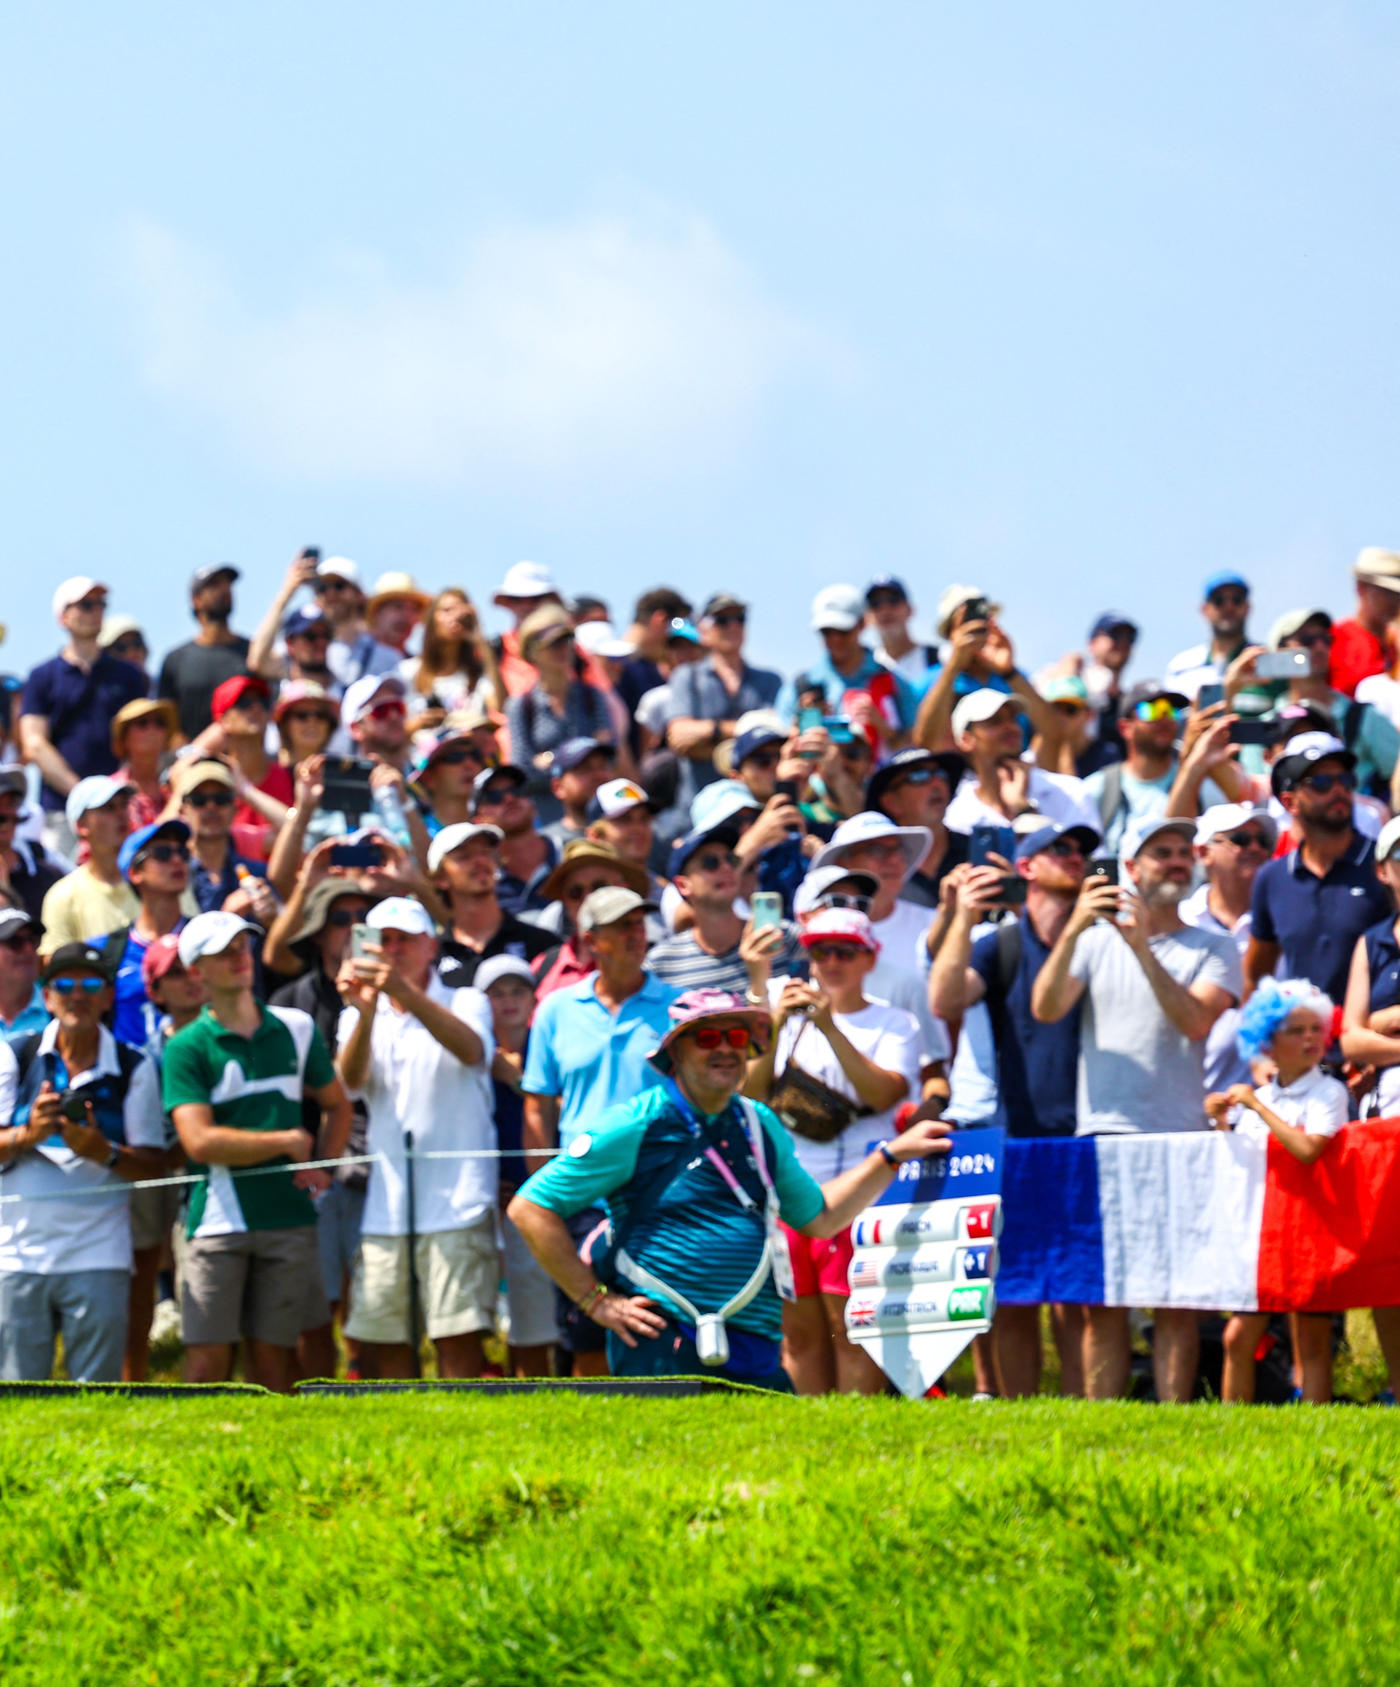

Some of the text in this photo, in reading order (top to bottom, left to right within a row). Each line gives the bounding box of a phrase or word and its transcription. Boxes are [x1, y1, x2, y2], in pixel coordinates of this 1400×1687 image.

[898, 1153, 995, 1181] PARIS 2024
[964, 1252, 987, 1271] +1
[950, 1290, 983, 1313] PAR
